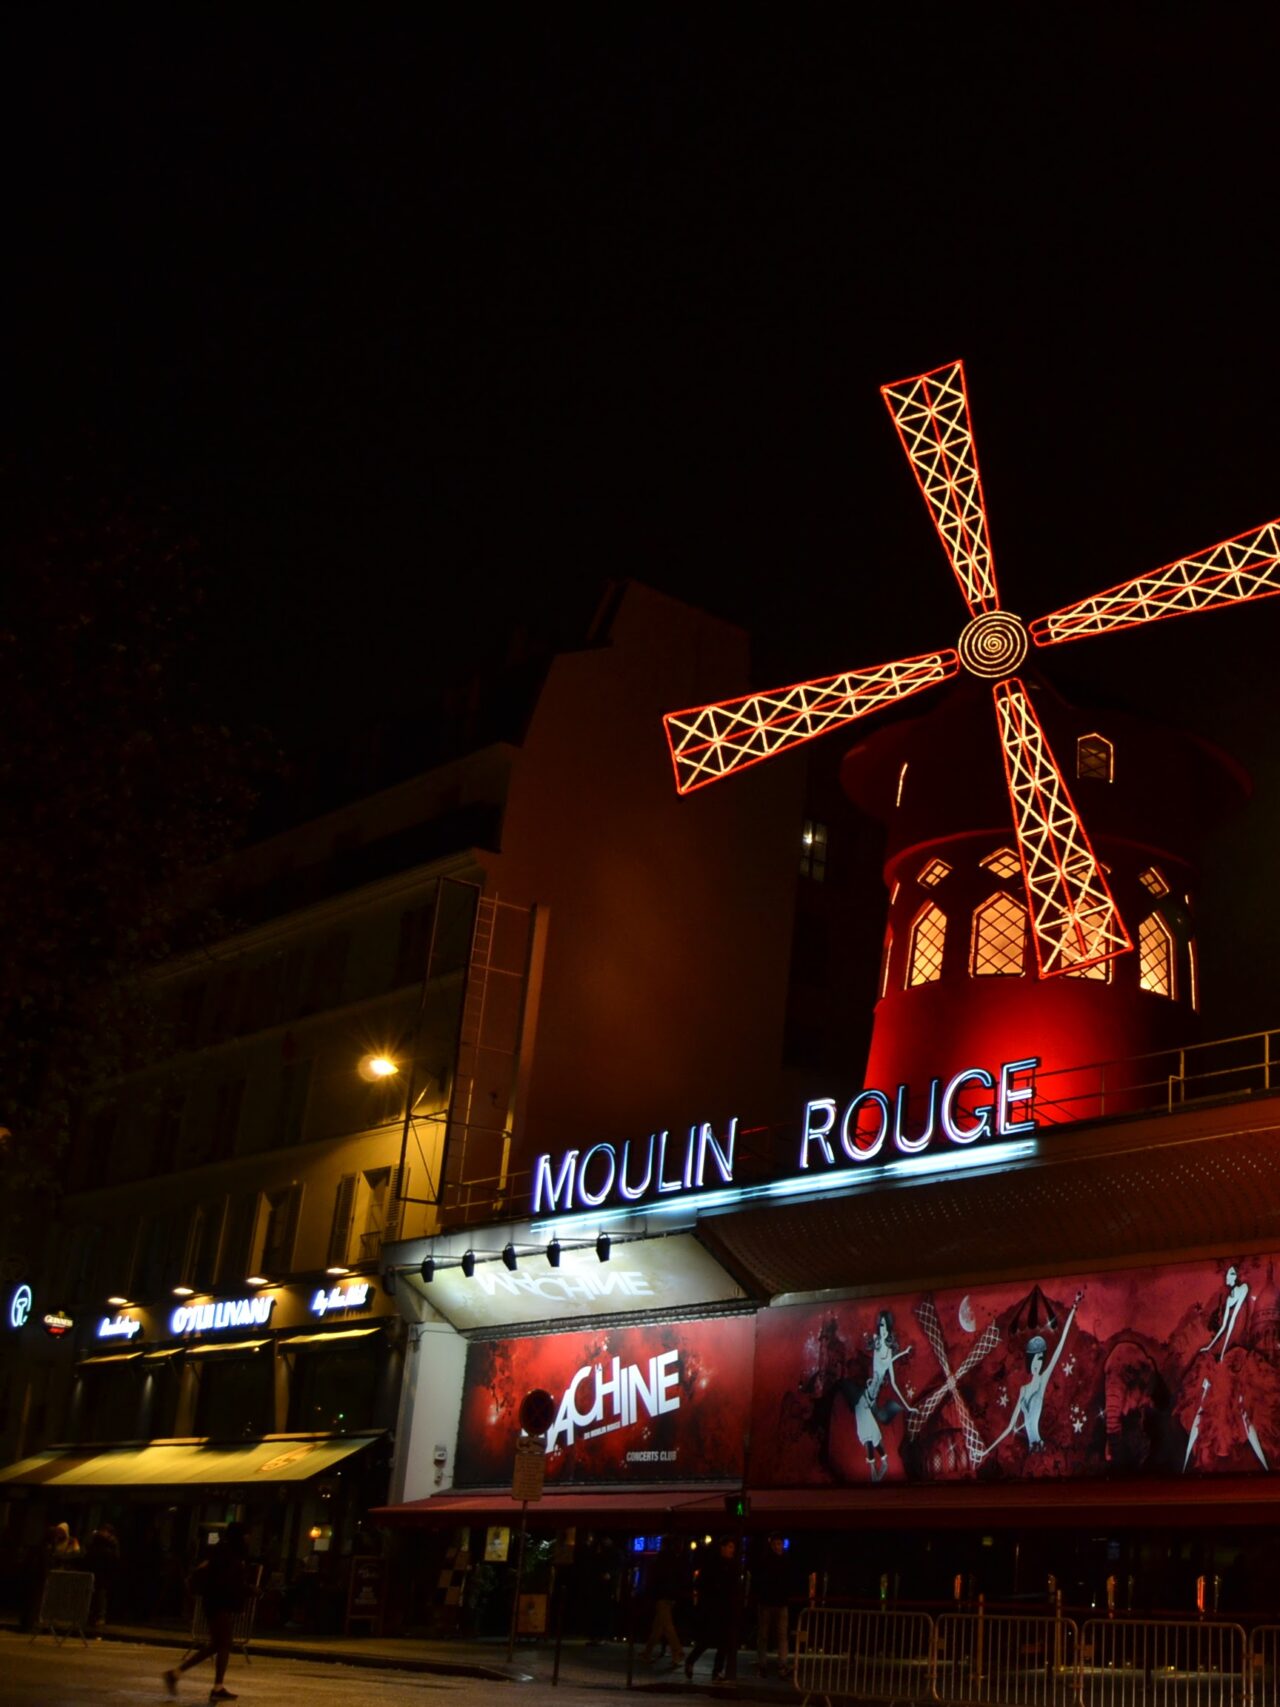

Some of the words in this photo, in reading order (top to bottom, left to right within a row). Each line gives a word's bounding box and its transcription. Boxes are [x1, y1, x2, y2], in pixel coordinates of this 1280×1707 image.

[534, 1117, 739, 1212] MOULIN
[801, 1057, 1040, 1169] ROUGE
[626, 1451, 659, 1462] CONCERTS
[660, 1449, 677, 1461] CLUB
